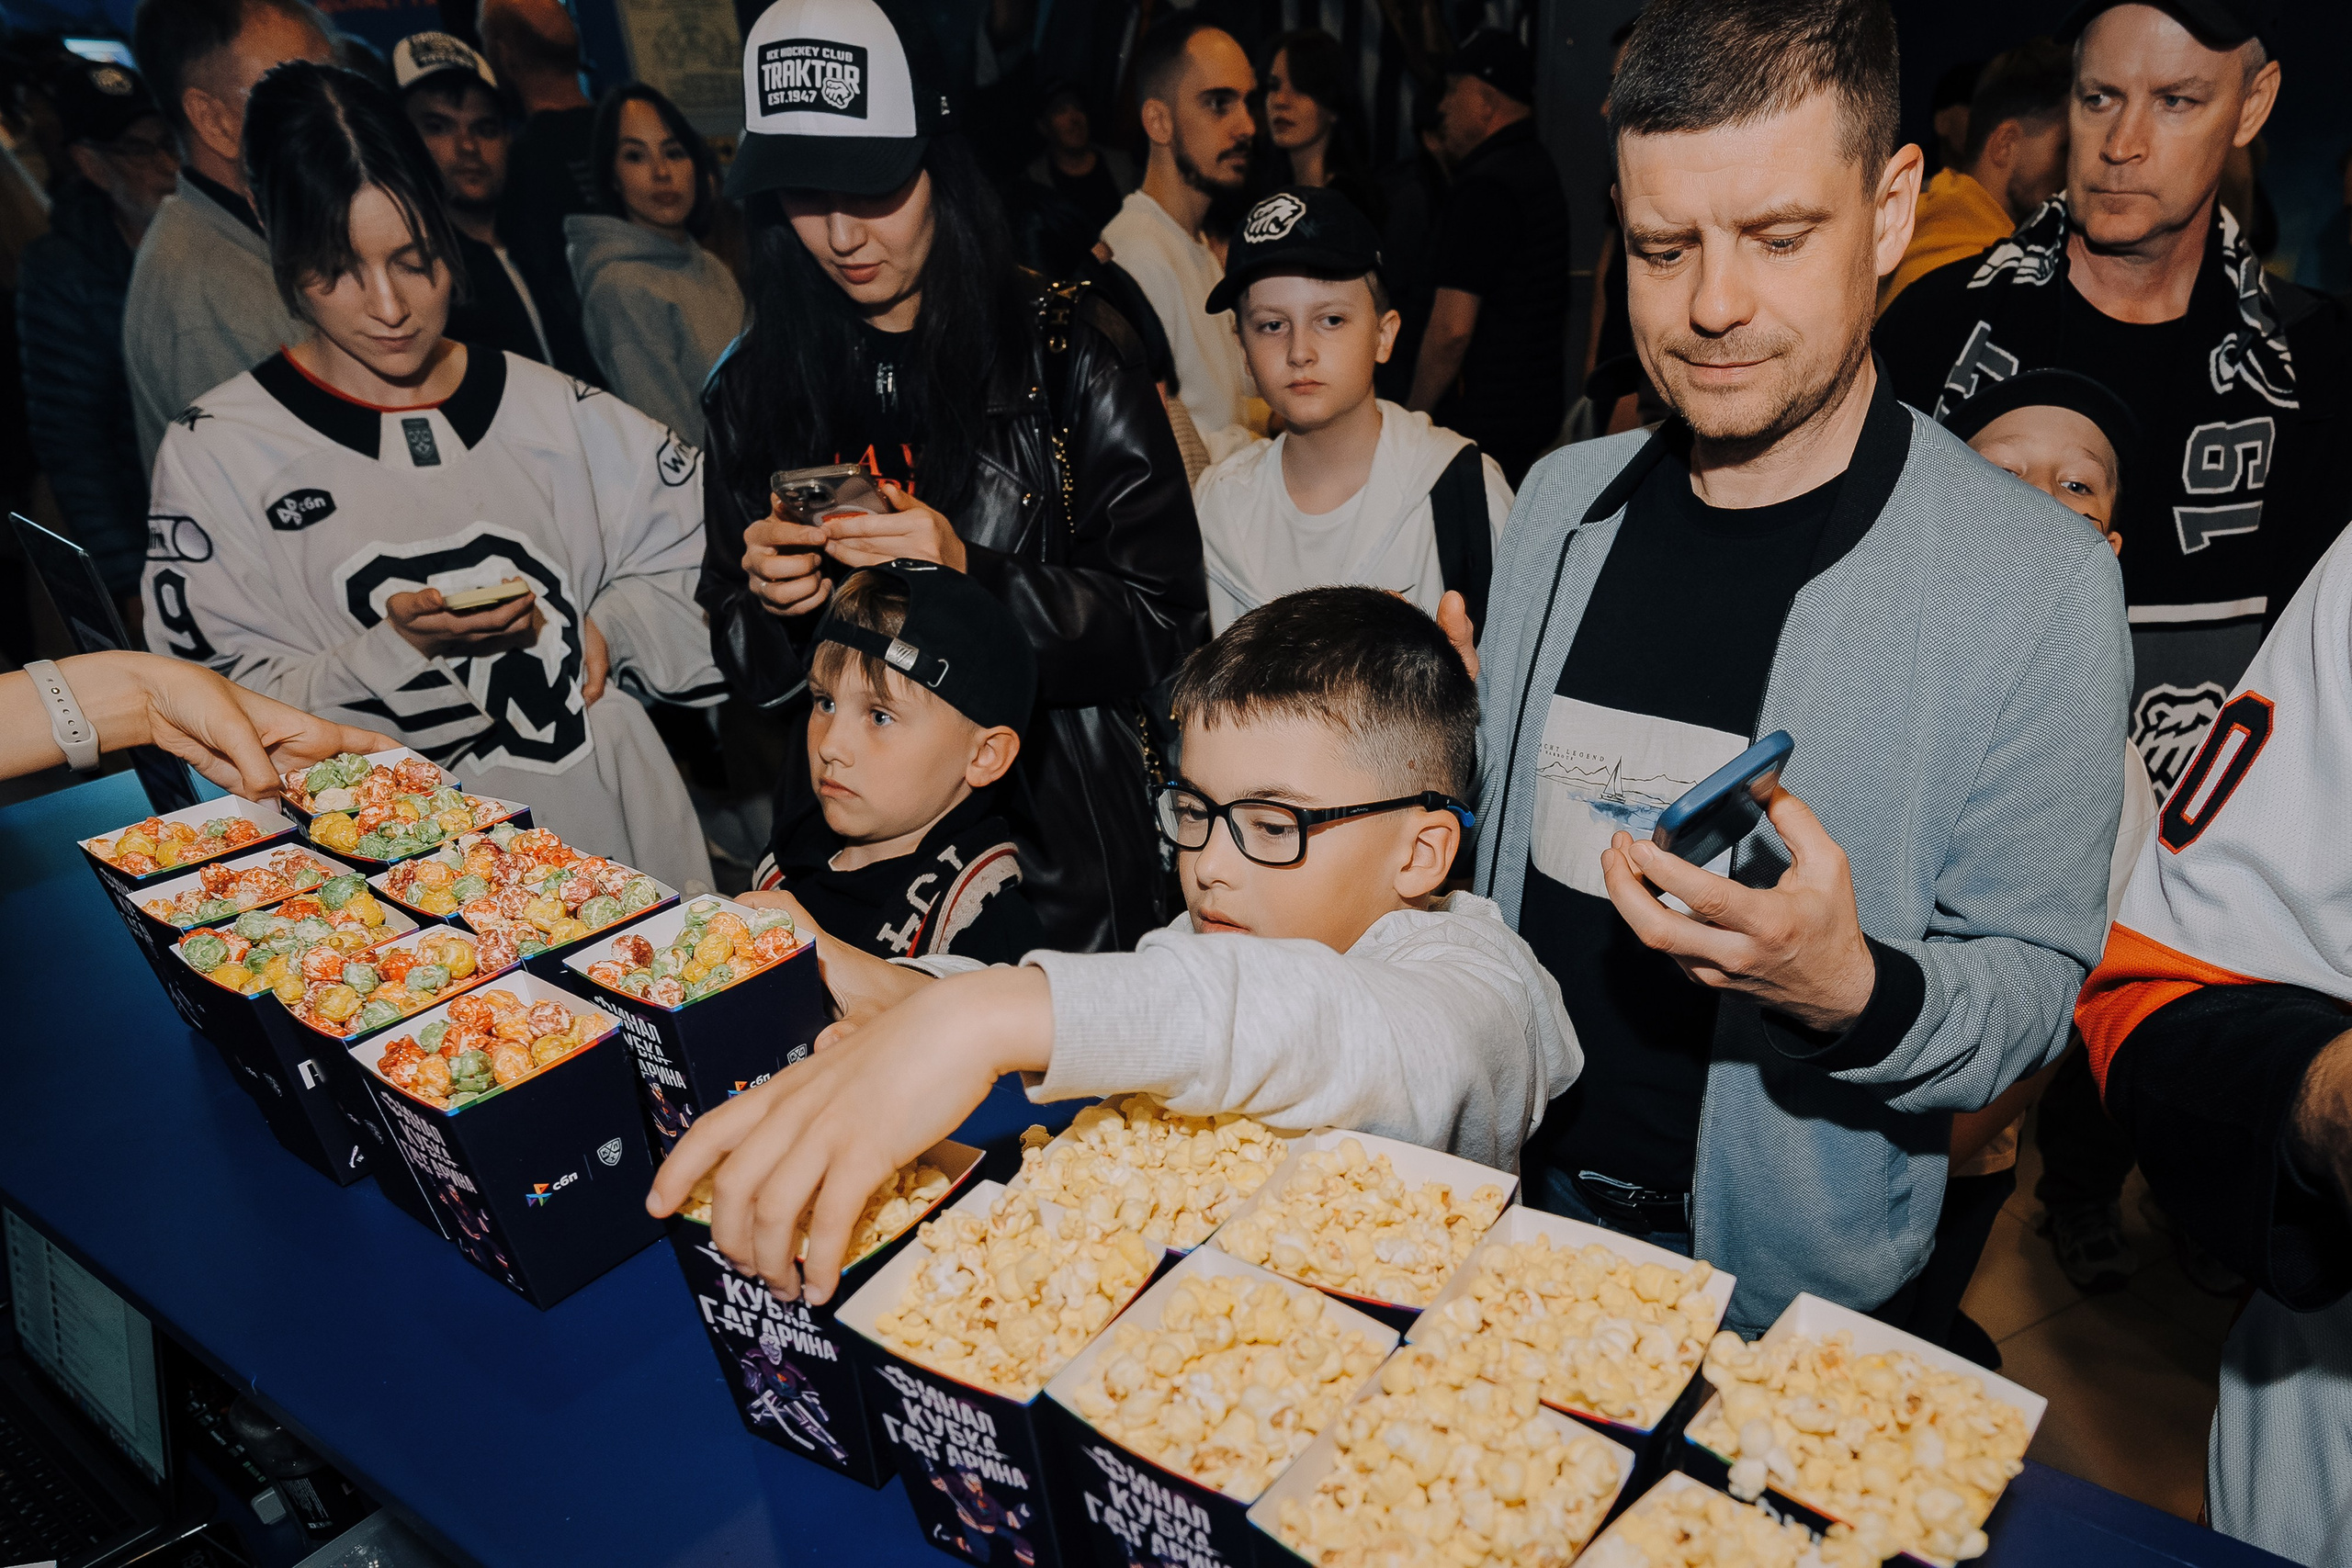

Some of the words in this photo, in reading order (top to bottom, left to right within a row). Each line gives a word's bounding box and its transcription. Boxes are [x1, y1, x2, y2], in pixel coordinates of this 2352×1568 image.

[761, 59, 862, 95] TRAKTOR
[780, 46, 820, 58] HOCKEY
[822, 48, 854, 62] CLUB
[767, 90, 818, 106] EST.1947
[622, 1032, 673, 1066] УБКА
[698, 1293, 839, 1362] ГАГАРИНА
[874, 1364, 998, 1438] ФИНАЛ
[901, 1396, 1011, 1461] КУБКА
[881, 1412, 1029, 1491] ГАГАРИНА
[1081, 1444, 1212, 1535] ФИНАЛ
[1107, 1480, 1224, 1558] КУБКА
[1083, 1490, 1232, 1568] ГАГАРИ
